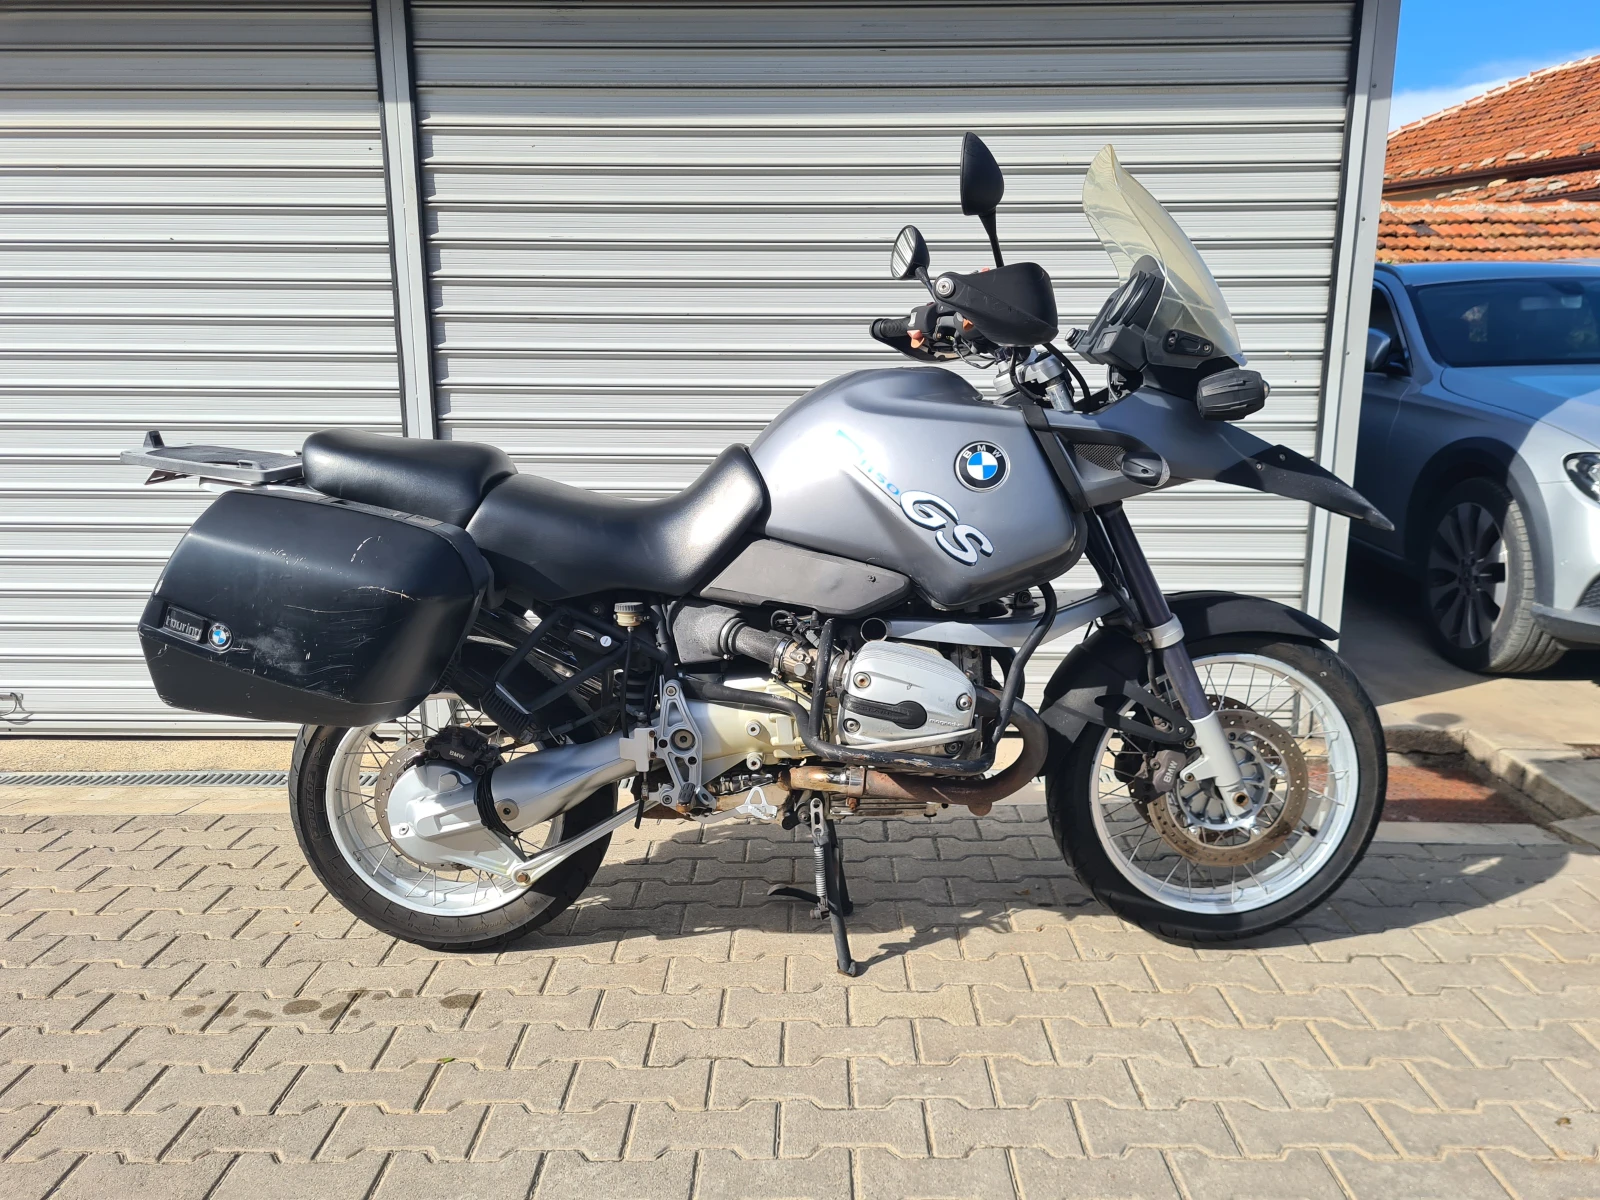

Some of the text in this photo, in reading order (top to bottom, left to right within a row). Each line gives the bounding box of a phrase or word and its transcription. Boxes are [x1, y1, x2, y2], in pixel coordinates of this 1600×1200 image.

[963, 444, 1002, 459] BMW
[900, 490, 994, 567] GS
[449, 750, 466, 760] BMW
[1163, 760, 1178, 783] BMW
